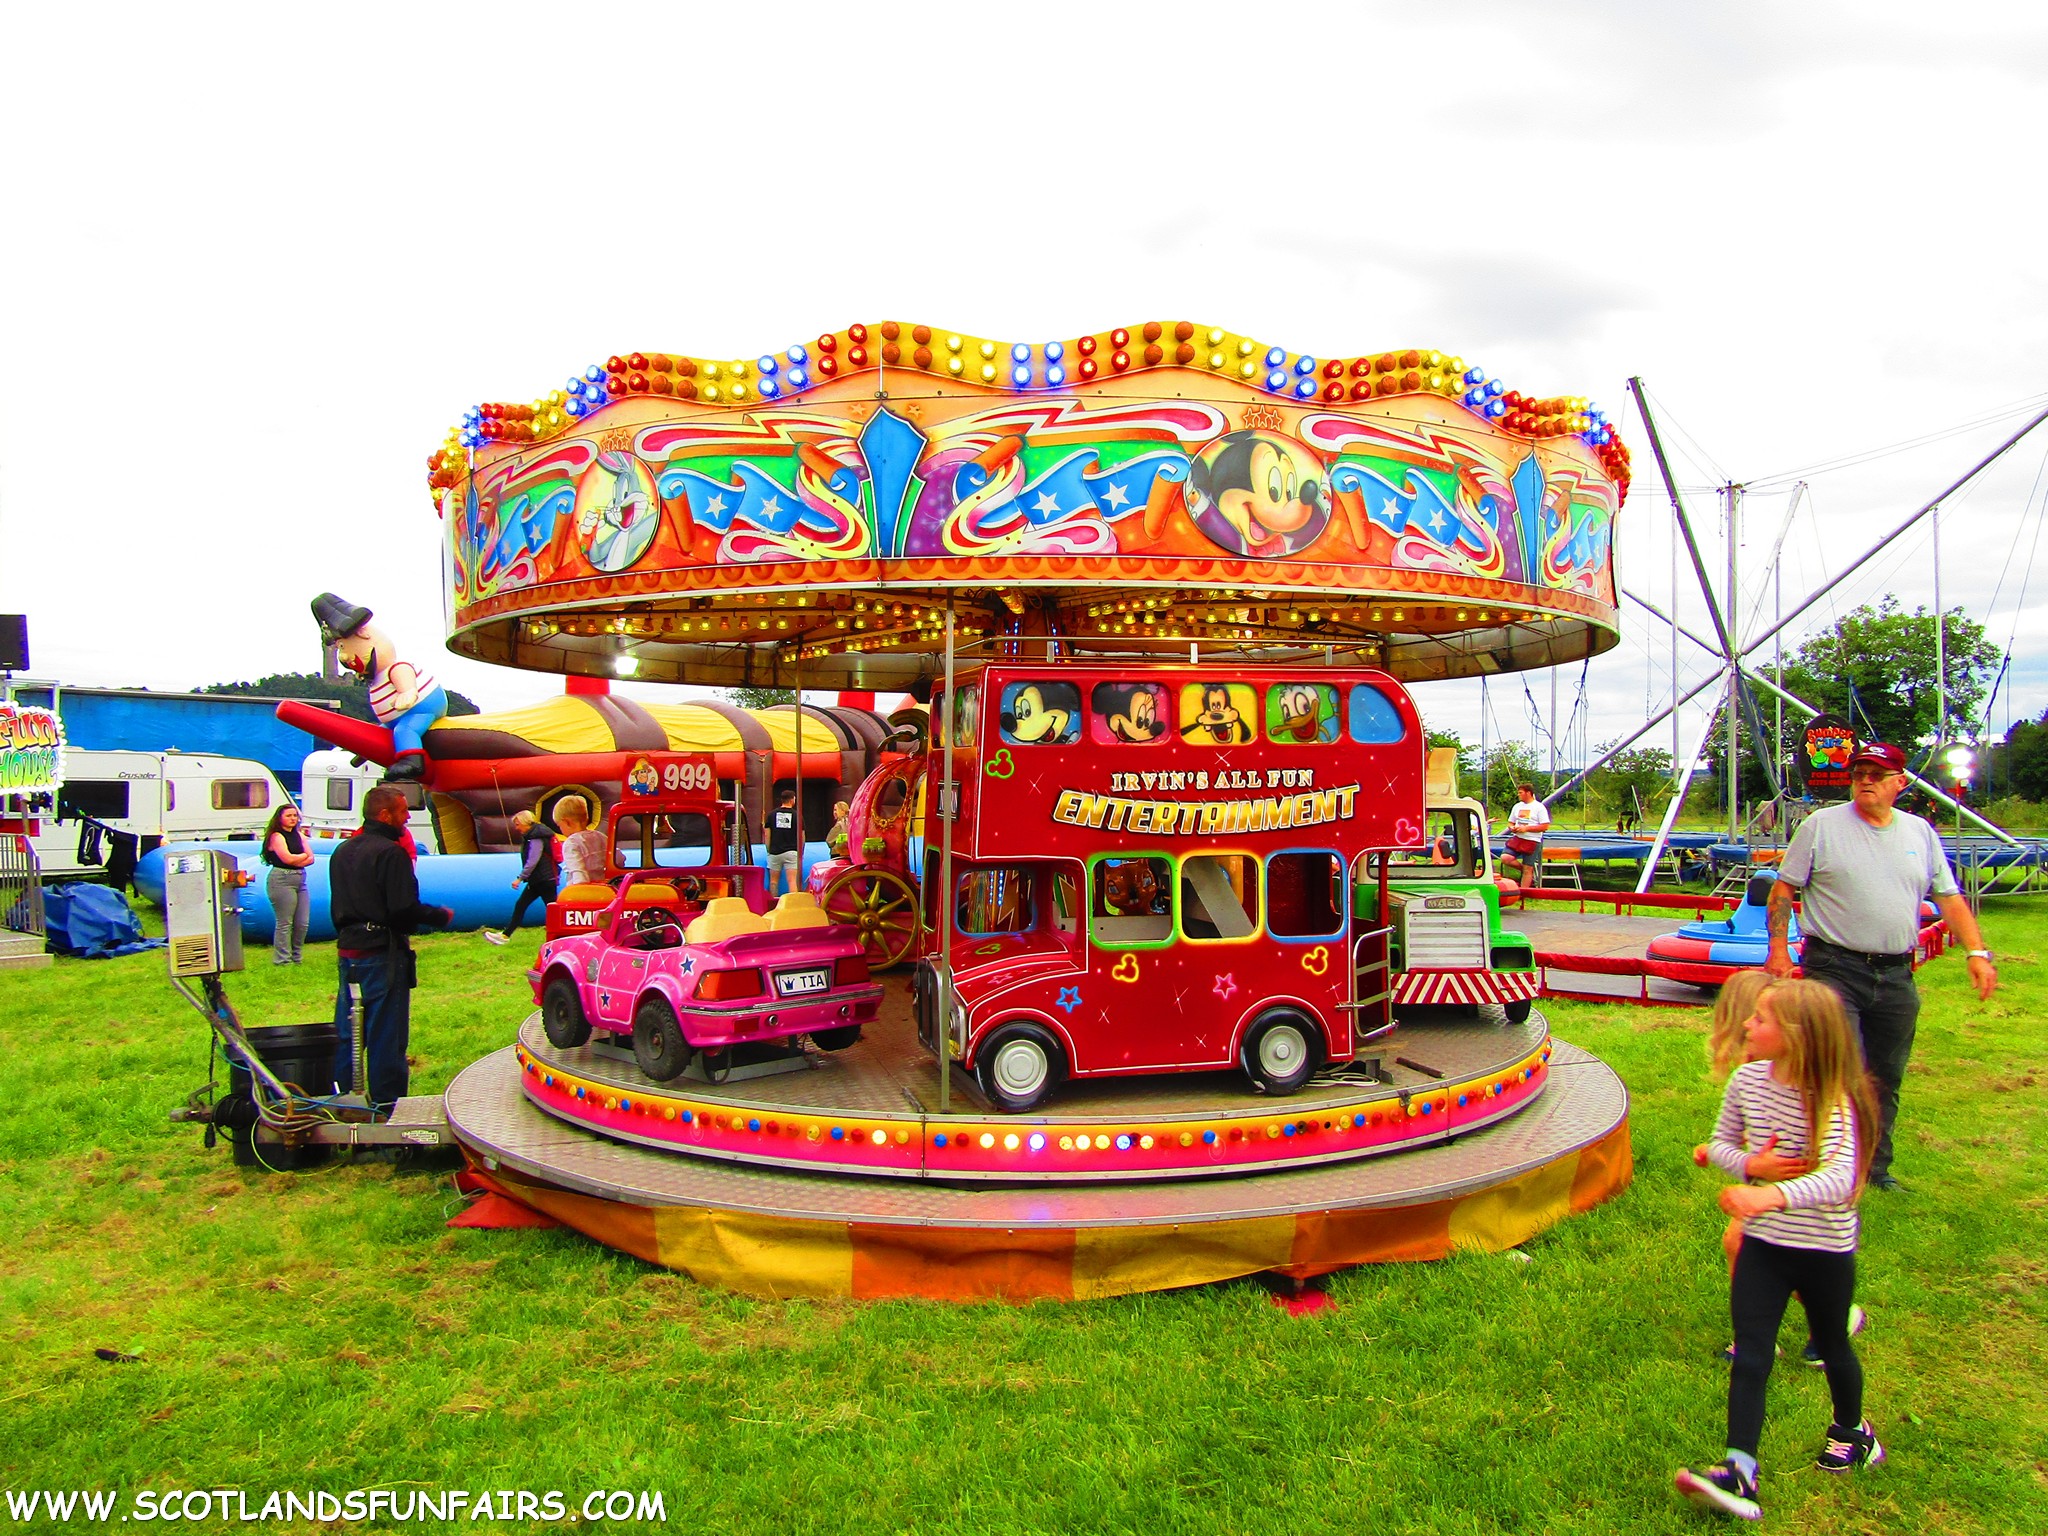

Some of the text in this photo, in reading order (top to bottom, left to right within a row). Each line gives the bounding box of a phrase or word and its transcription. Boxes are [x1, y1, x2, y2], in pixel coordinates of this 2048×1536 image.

[663, 763, 711, 791] 999
[1112, 769, 1314, 792] IRVIN'S ALL FUN
[1052, 784, 1361, 835] ENTERTAINMENT
[799, 974, 825, 988] TIA
